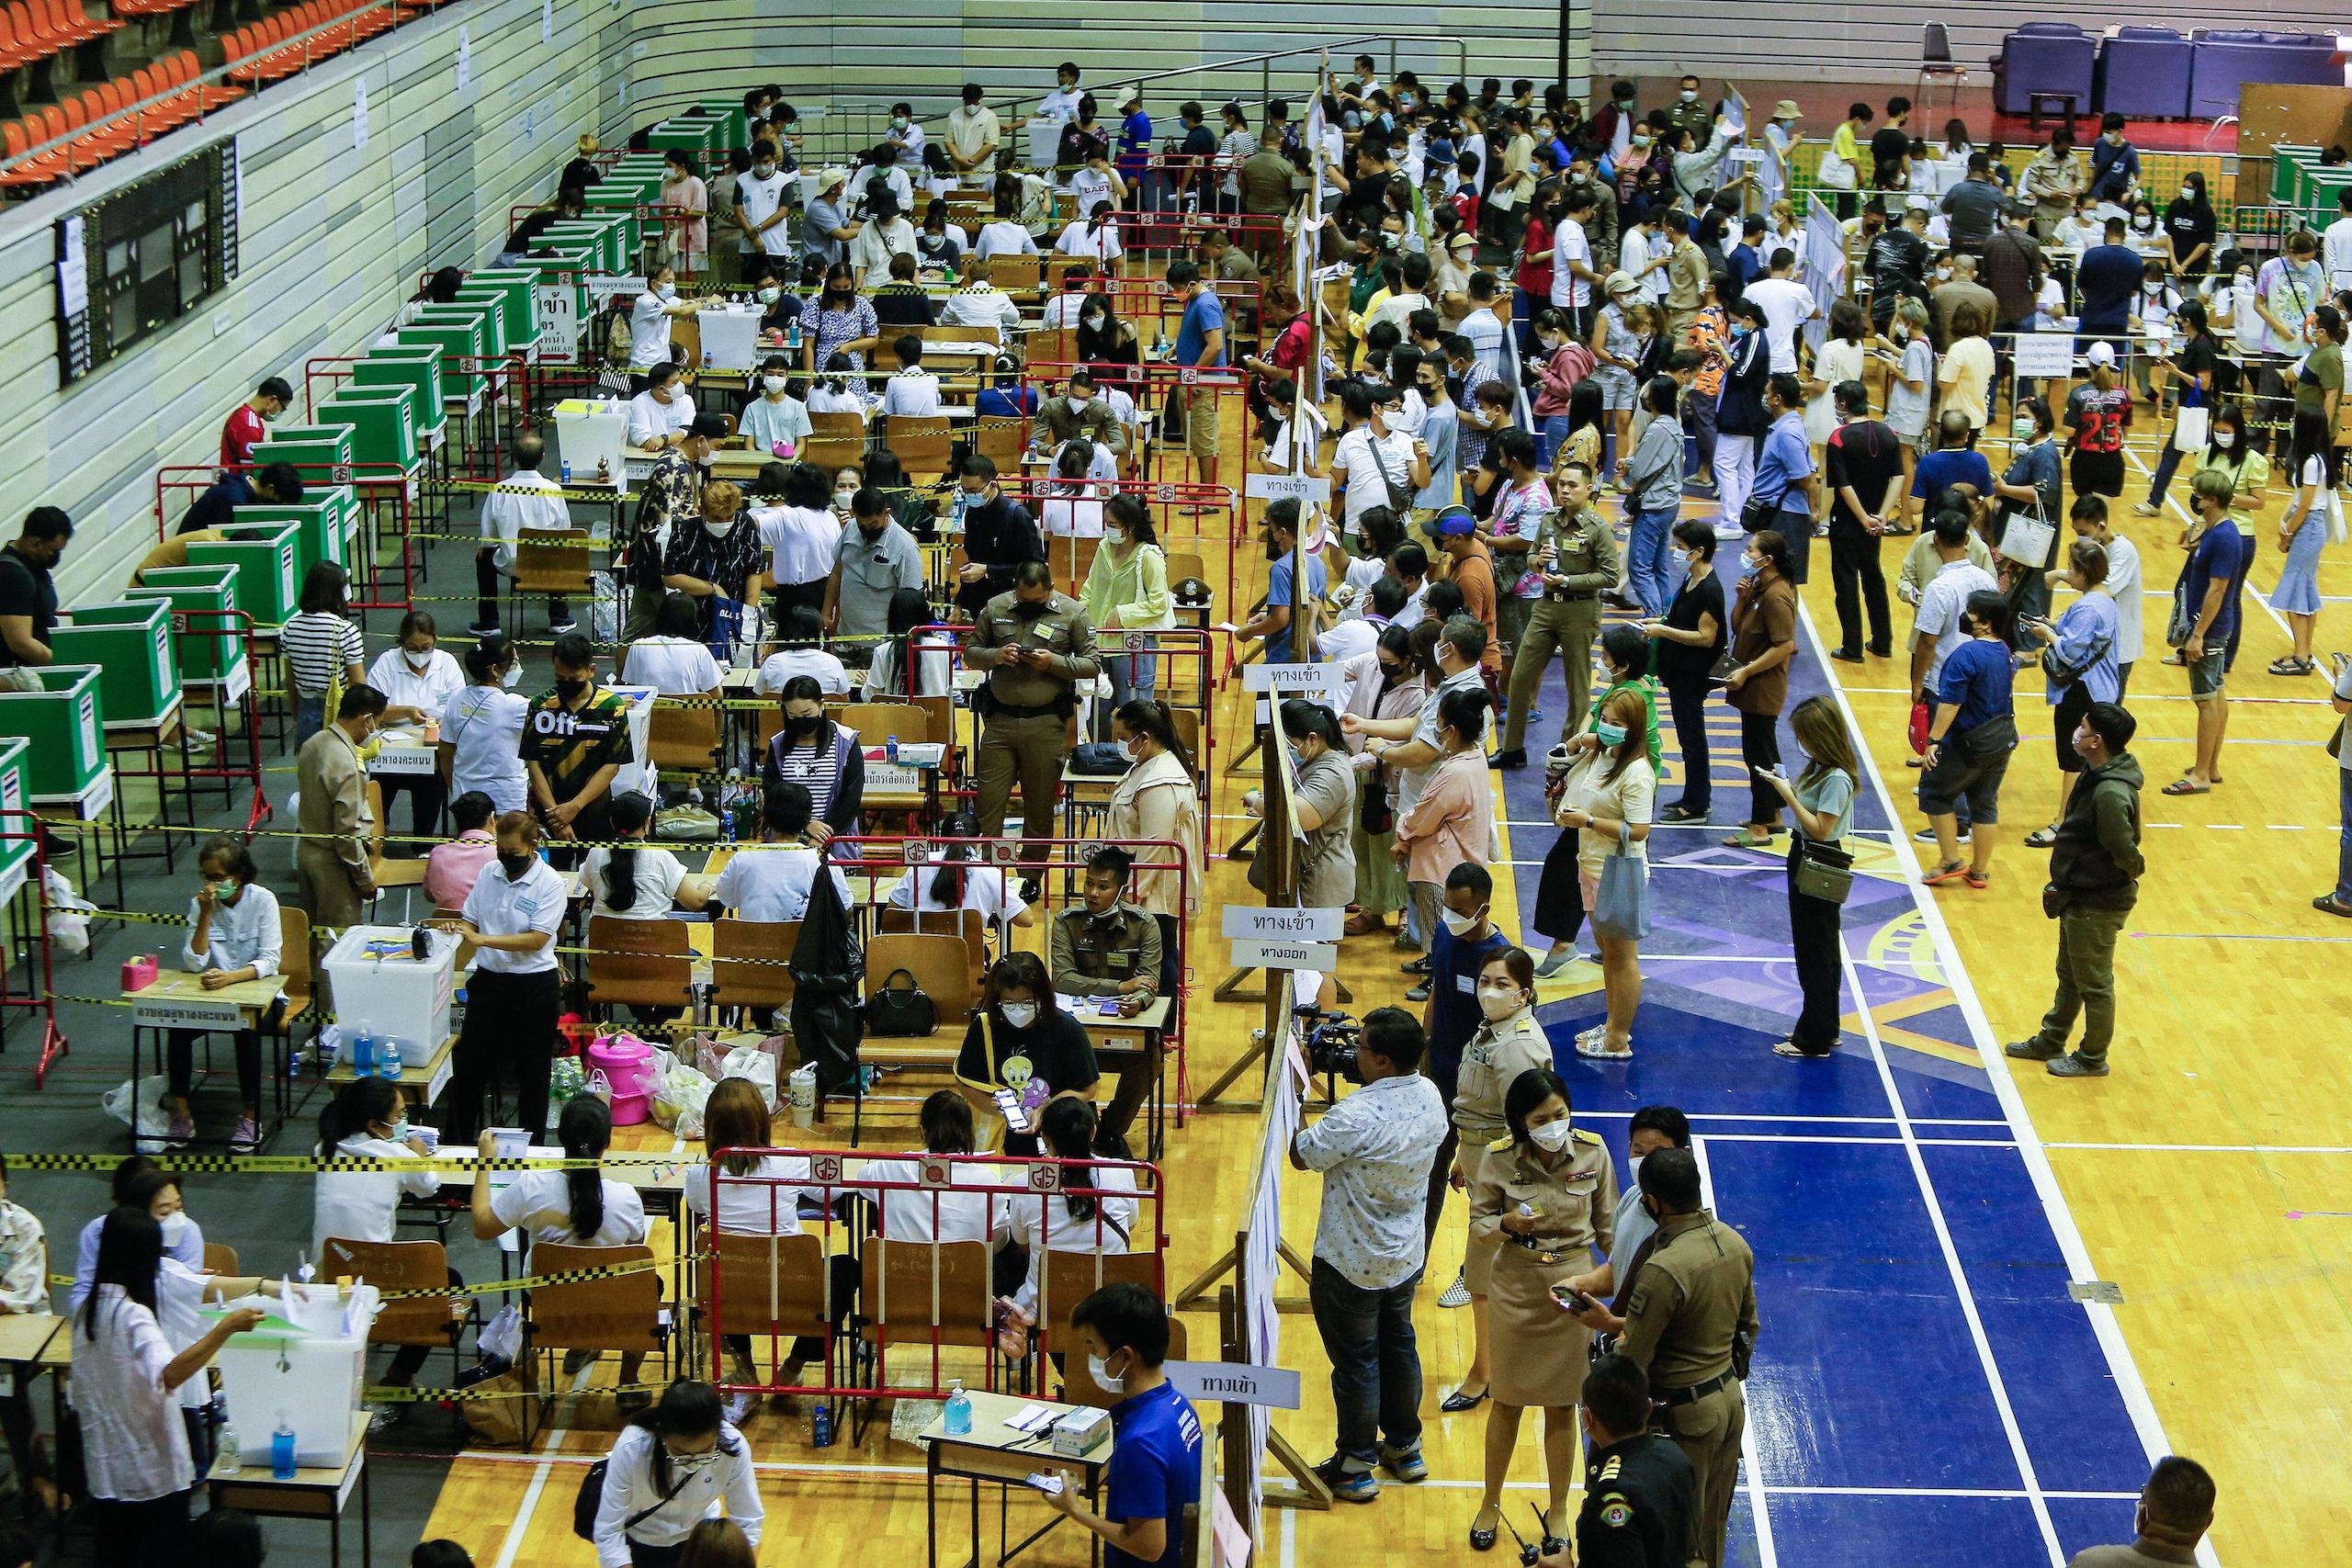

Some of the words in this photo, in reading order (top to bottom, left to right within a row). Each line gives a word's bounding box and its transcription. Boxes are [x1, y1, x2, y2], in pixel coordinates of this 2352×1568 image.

[1084, 185, 1110, 194] BABY
[2078, 412, 2122, 451] 23
[1266, 478, 1307, 492] ทางเข้า
[1272, 664, 1321, 682] ทางเข้า
[1253, 910, 1314, 931] ทางเข้า
[1261, 947, 1307, 960] ทางออก
[1201, 1374, 1257, 1395] ทางเข้า
